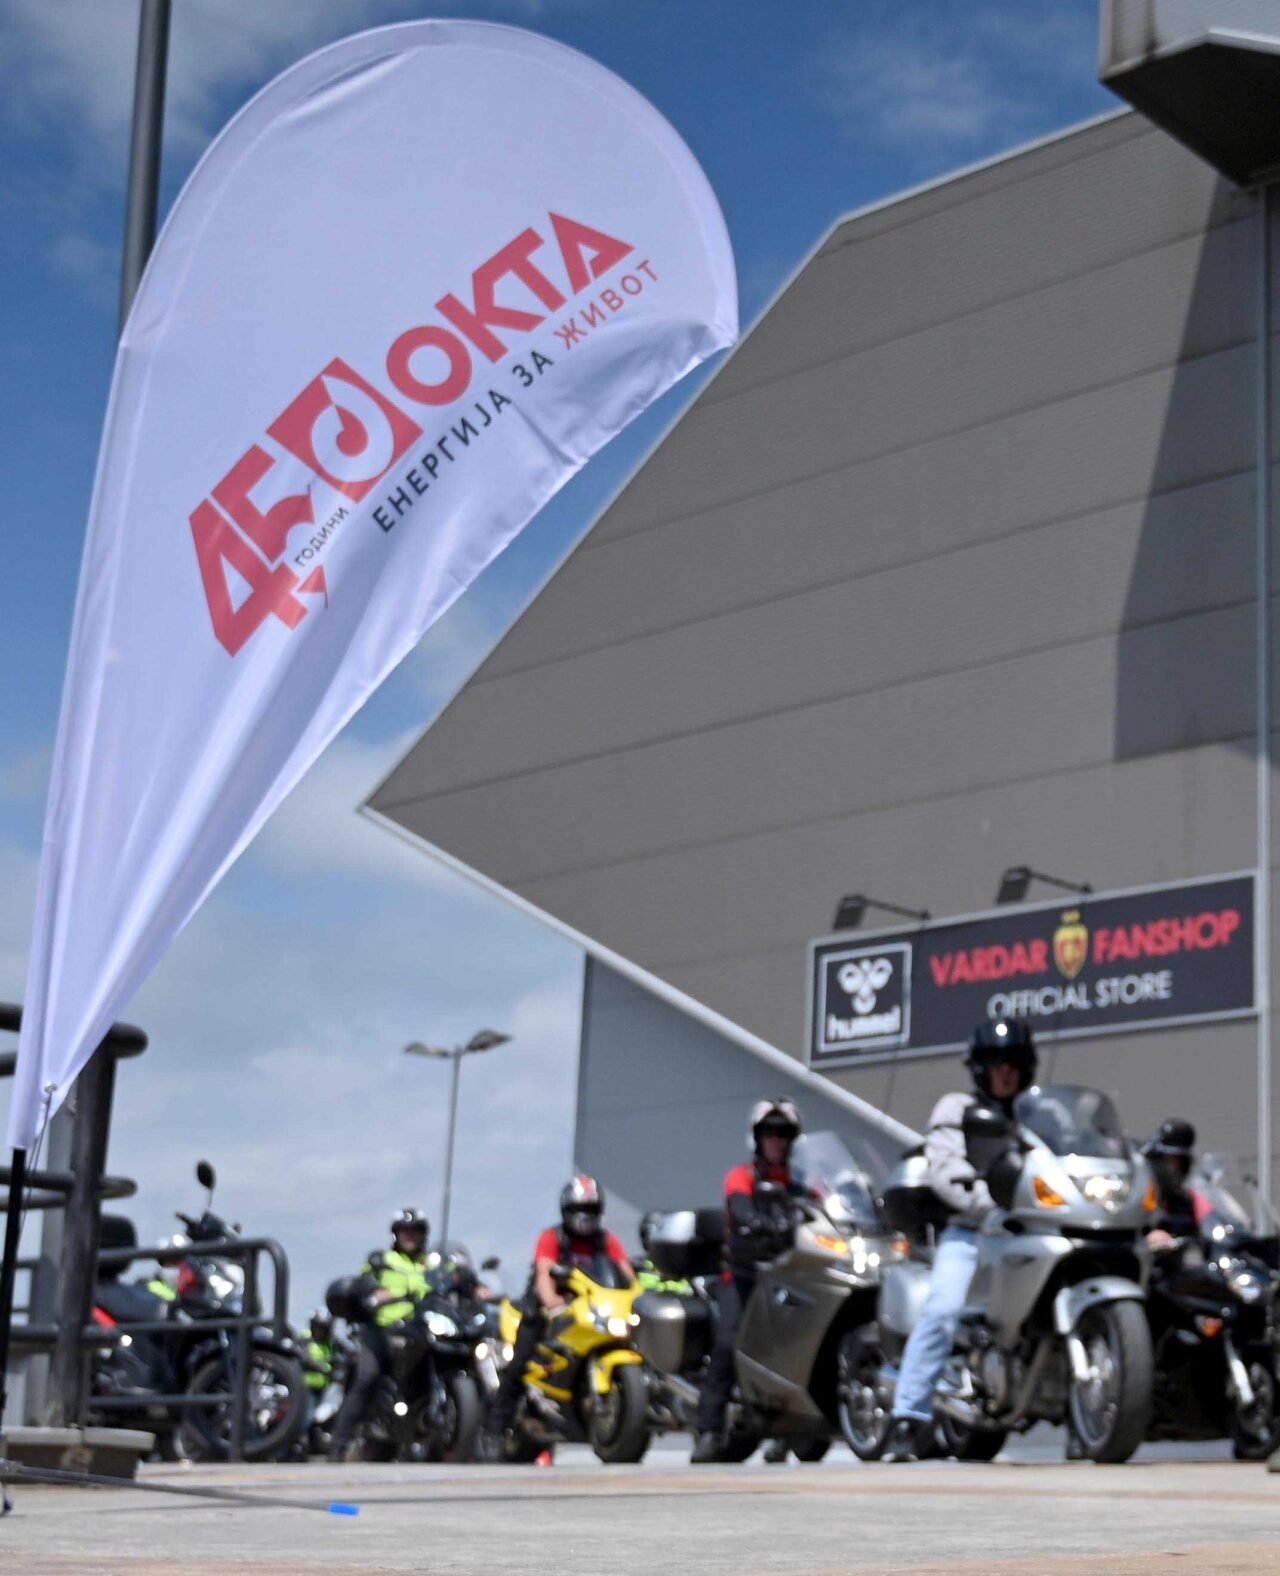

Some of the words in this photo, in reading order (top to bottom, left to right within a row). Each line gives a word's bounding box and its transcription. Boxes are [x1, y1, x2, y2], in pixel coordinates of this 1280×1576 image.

[386, 211, 635, 406] ОКТА
[372, 388, 512, 533] ЕНЕРГИЈА
[511, 350, 554, 388] ЗА
[553, 259, 659, 350] ЖИВОТ
[294, 506, 350, 567] ГОДИНИ
[930, 938, 1048, 987] VARDAR
[1093, 909, 1242, 964] FANSHOP
[985, 982, 1090, 1020] OFFICIAL
[1094, 970, 1173, 1008] STORE
